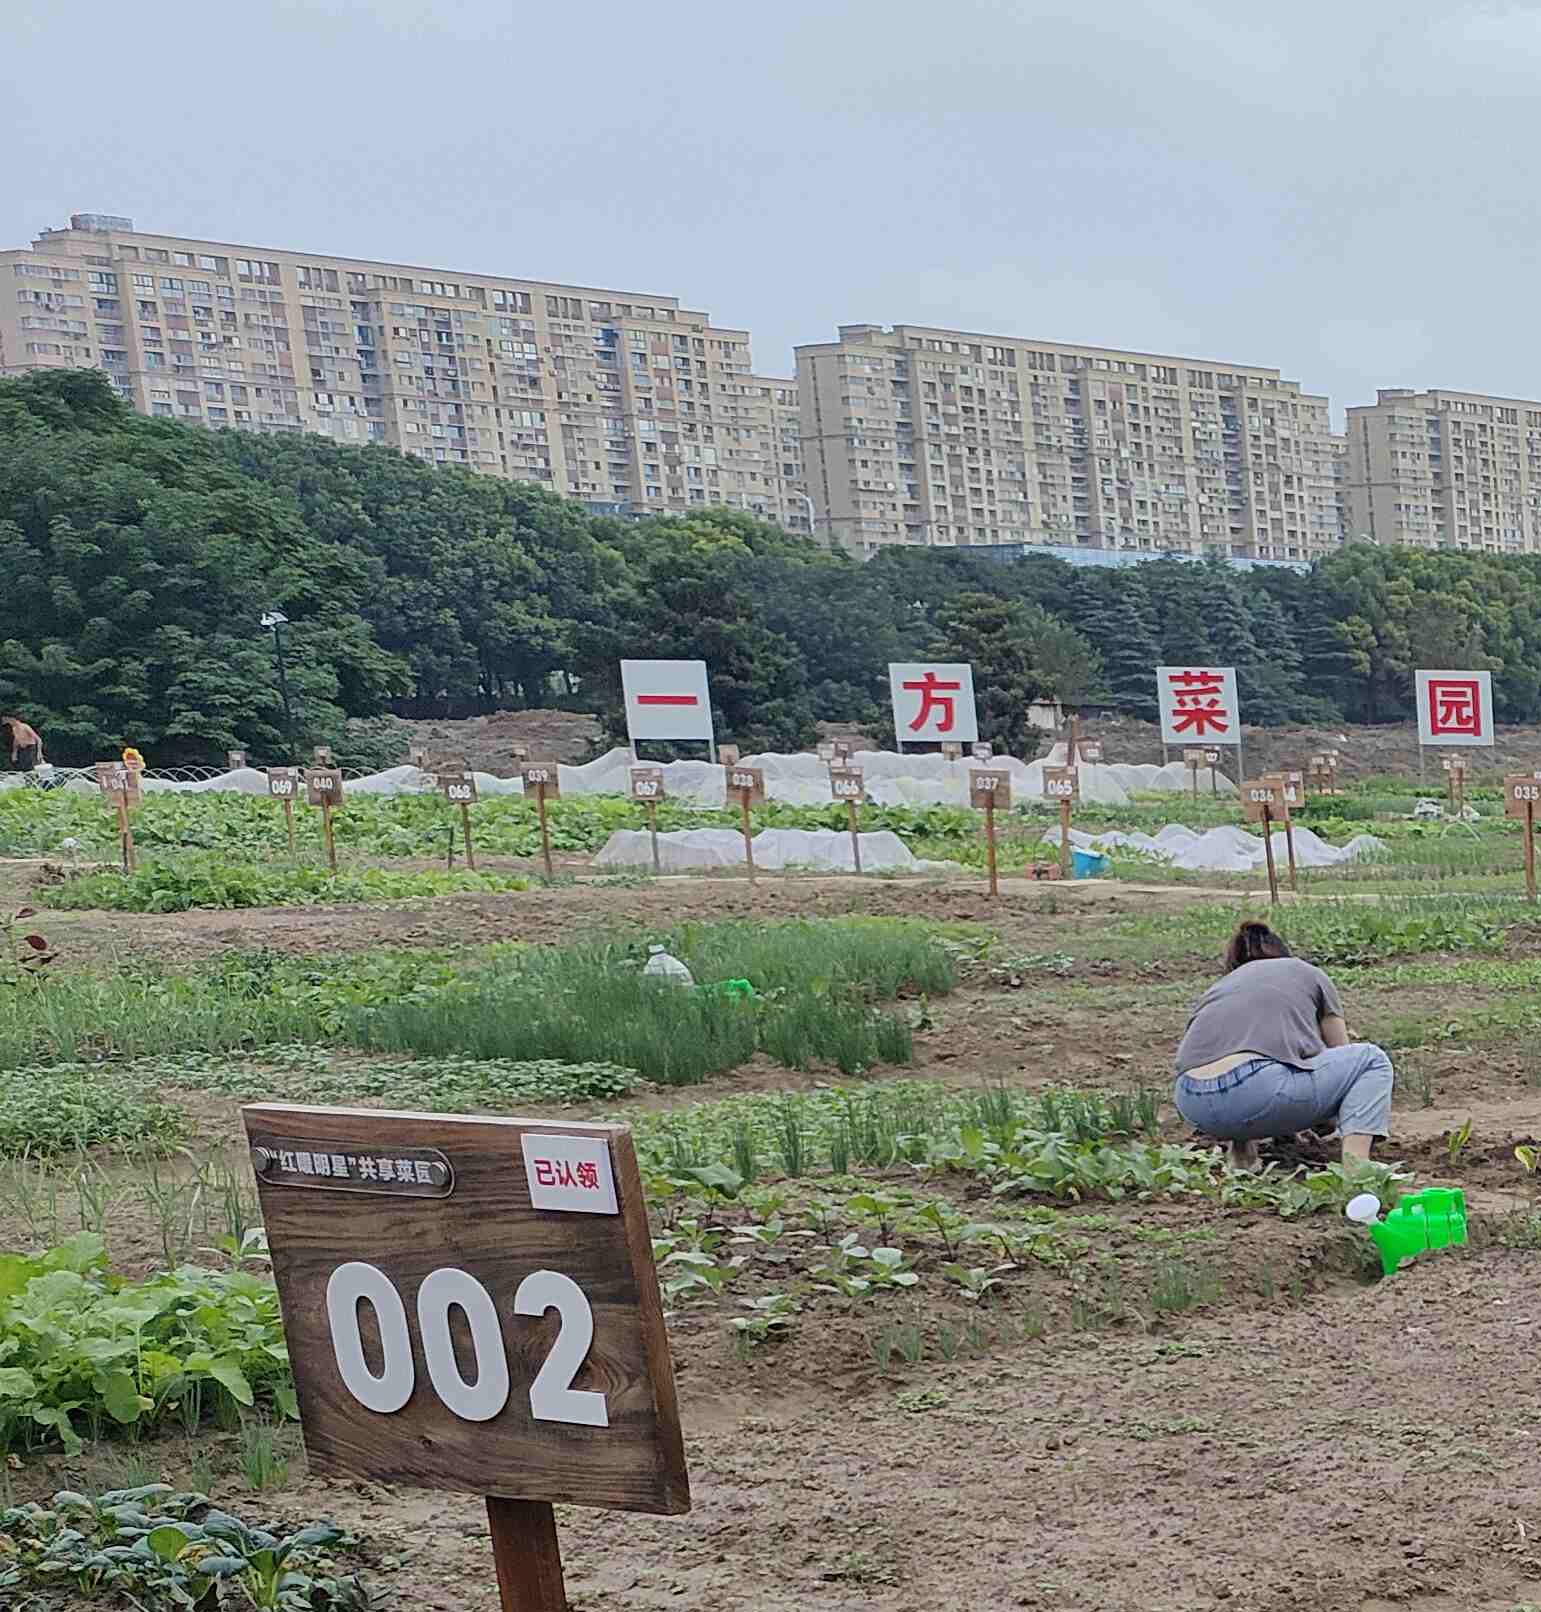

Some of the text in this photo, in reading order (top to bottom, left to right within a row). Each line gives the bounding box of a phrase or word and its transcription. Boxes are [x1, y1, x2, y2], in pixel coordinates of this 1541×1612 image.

[637, 695, 698, 705] 一
[903, 671, 960, 732] 方
[1168, 671, 1229, 735] 菜
[1428, 680, 1481, 736] 园
[528, 769, 549, 783] 039
[271, 780, 293, 794] 069
[1047, 779, 1073, 796] 065
[1513, 785, 1540, 801] 035
[1250, 788, 1274, 803] 036
[534, 1159, 599, 1190] 已认领
[326, 1261, 609, 1428] 002
